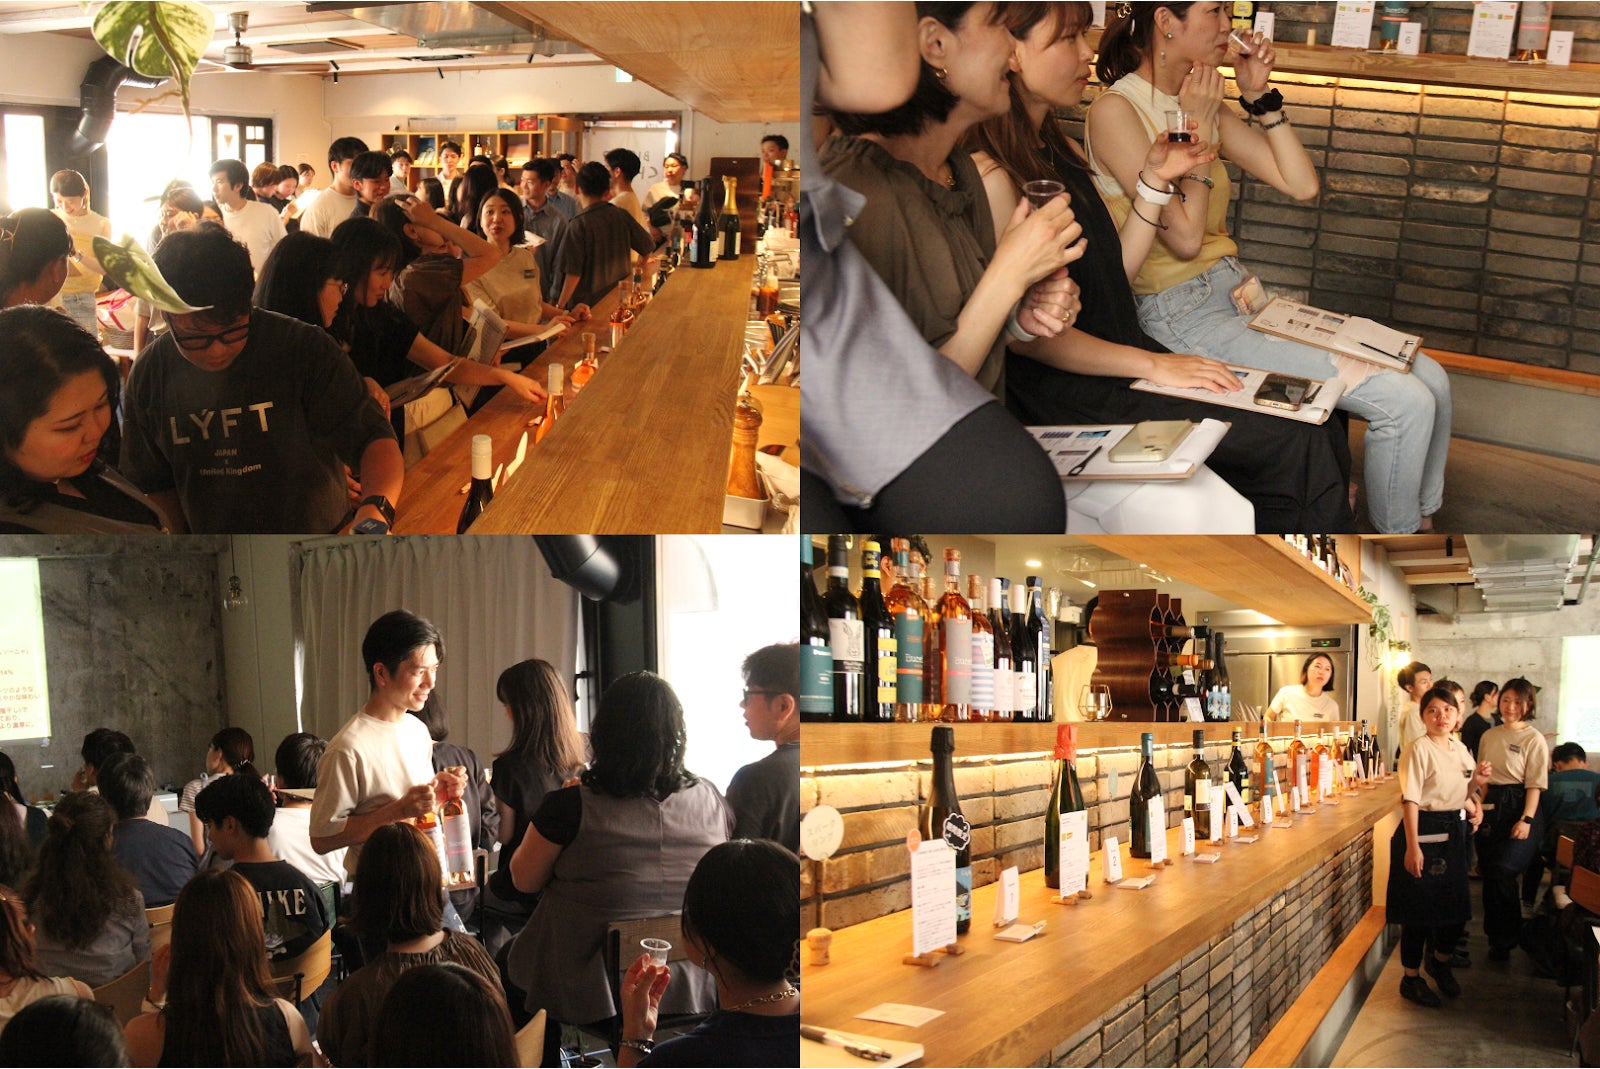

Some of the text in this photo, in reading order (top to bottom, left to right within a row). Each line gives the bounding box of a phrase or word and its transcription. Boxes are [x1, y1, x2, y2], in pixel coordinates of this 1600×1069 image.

[1556, 45, 1564, 54] 7
[214, 448, 238, 457] JAPAN
[225, 464, 262, 476] Kingdom
[1112, 856, 1117, 867] 2
